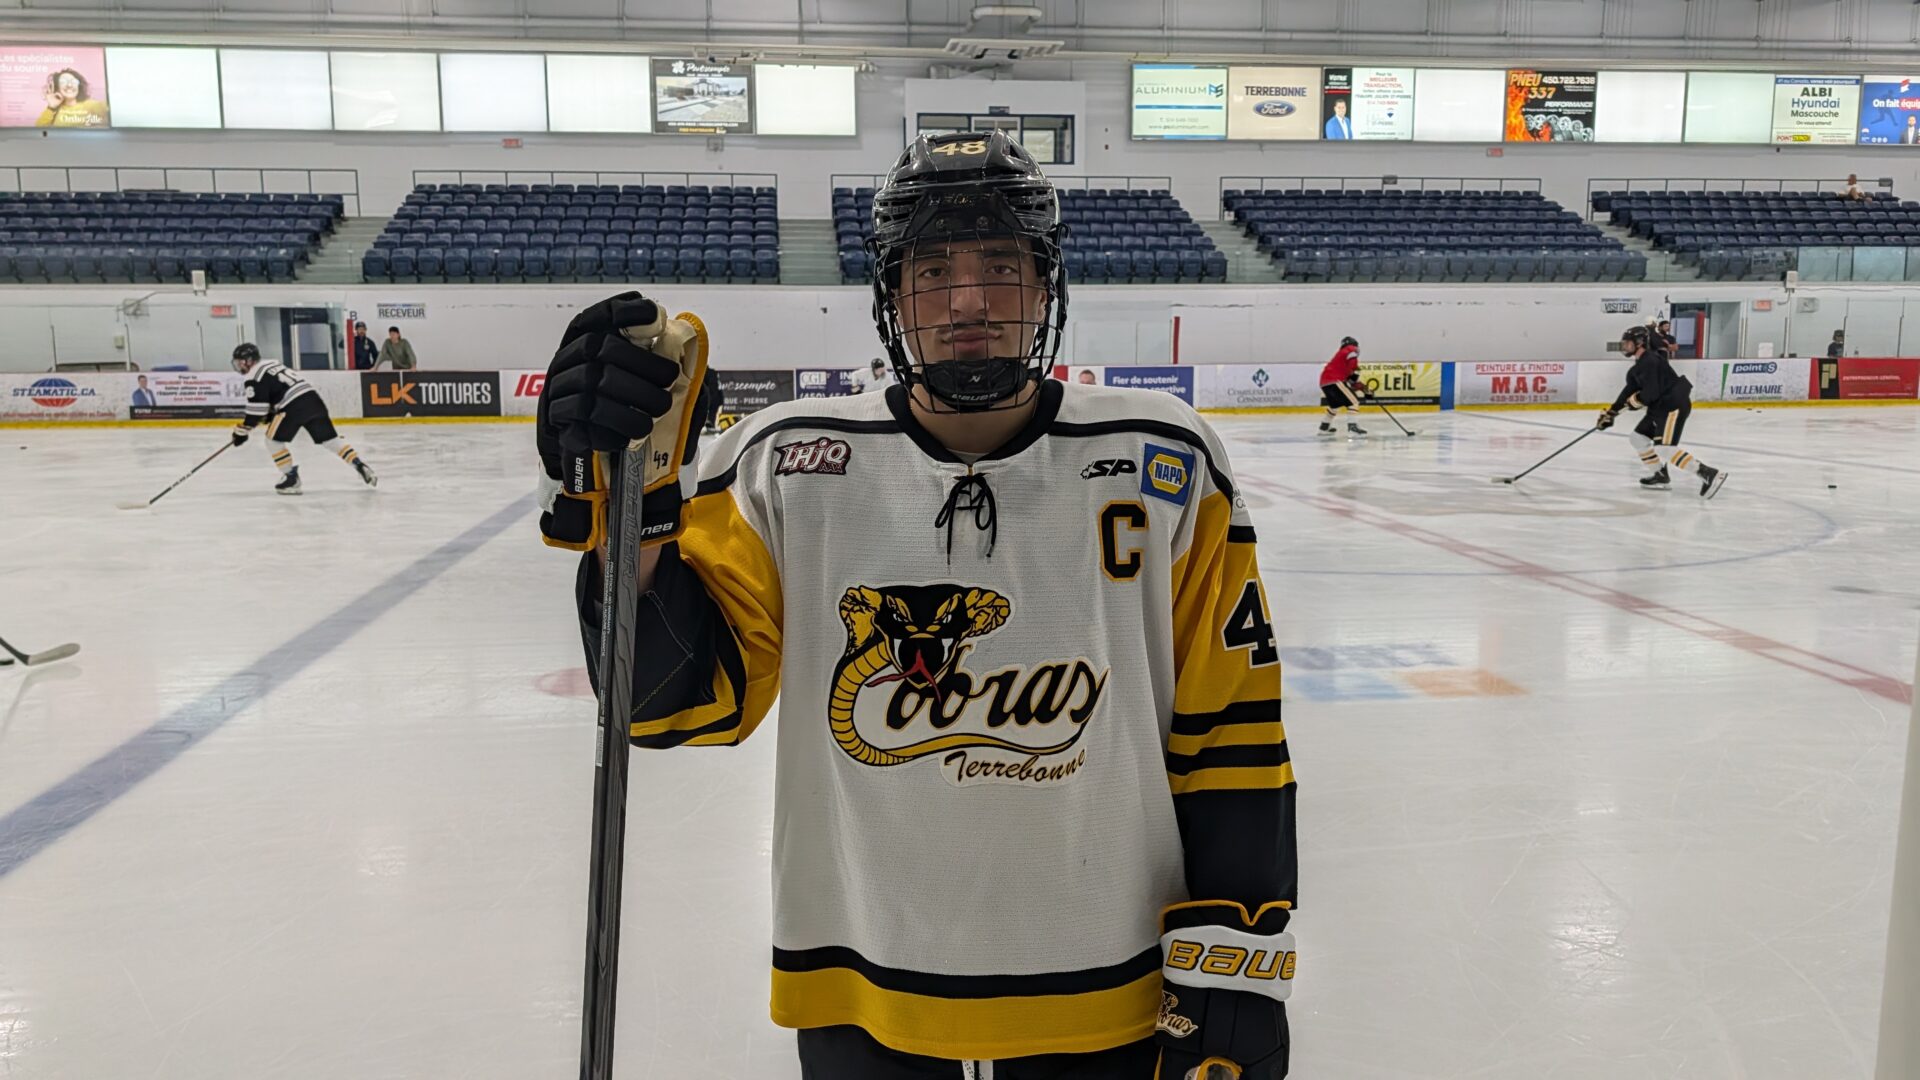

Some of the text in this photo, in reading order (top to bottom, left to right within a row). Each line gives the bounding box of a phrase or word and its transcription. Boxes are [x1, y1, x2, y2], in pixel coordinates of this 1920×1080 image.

[1509, 73, 1542, 87] PNEU
[1135, 86, 1207, 95] ALUMINIUM
[1244, 86, 1307, 97] TERREBONNE
[1528, 87, 1556, 99] 337
[1800, 87, 1832, 97] ALBI
[1261, 102, 1288, 115] Ford
[1791, 98, 1840, 109] Hyundai
[1873, 99, 1885, 107] On
[1886, 99, 1899, 107] fait
[1790, 110, 1839, 118] Mascouche
[932, 140, 987, 156] 48
[378, 307, 425, 318] RECEVEUR
[1604, 302, 1638, 313] VISITEUR
[1475, 363, 1516, 372] PEINTURE
[1528, 363, 1565, 372] FINITION
[1735, 364, 1762, 373] point
[1112, 375, 1179, 384] Fier de soutenir
[1491, 376, 1547, 394] MAC
[12, 387, 96, 397] STEAMATIC.CA
[370, 382, 492, 405] LK TOITURES
[1730, 384, 1784, 395] VILLEMAIRE
[1155, 462, 1183, 486] NAPA
[1098, 500, 1149, 582] C
[944, 749, 1086, 783] Terrebonne
